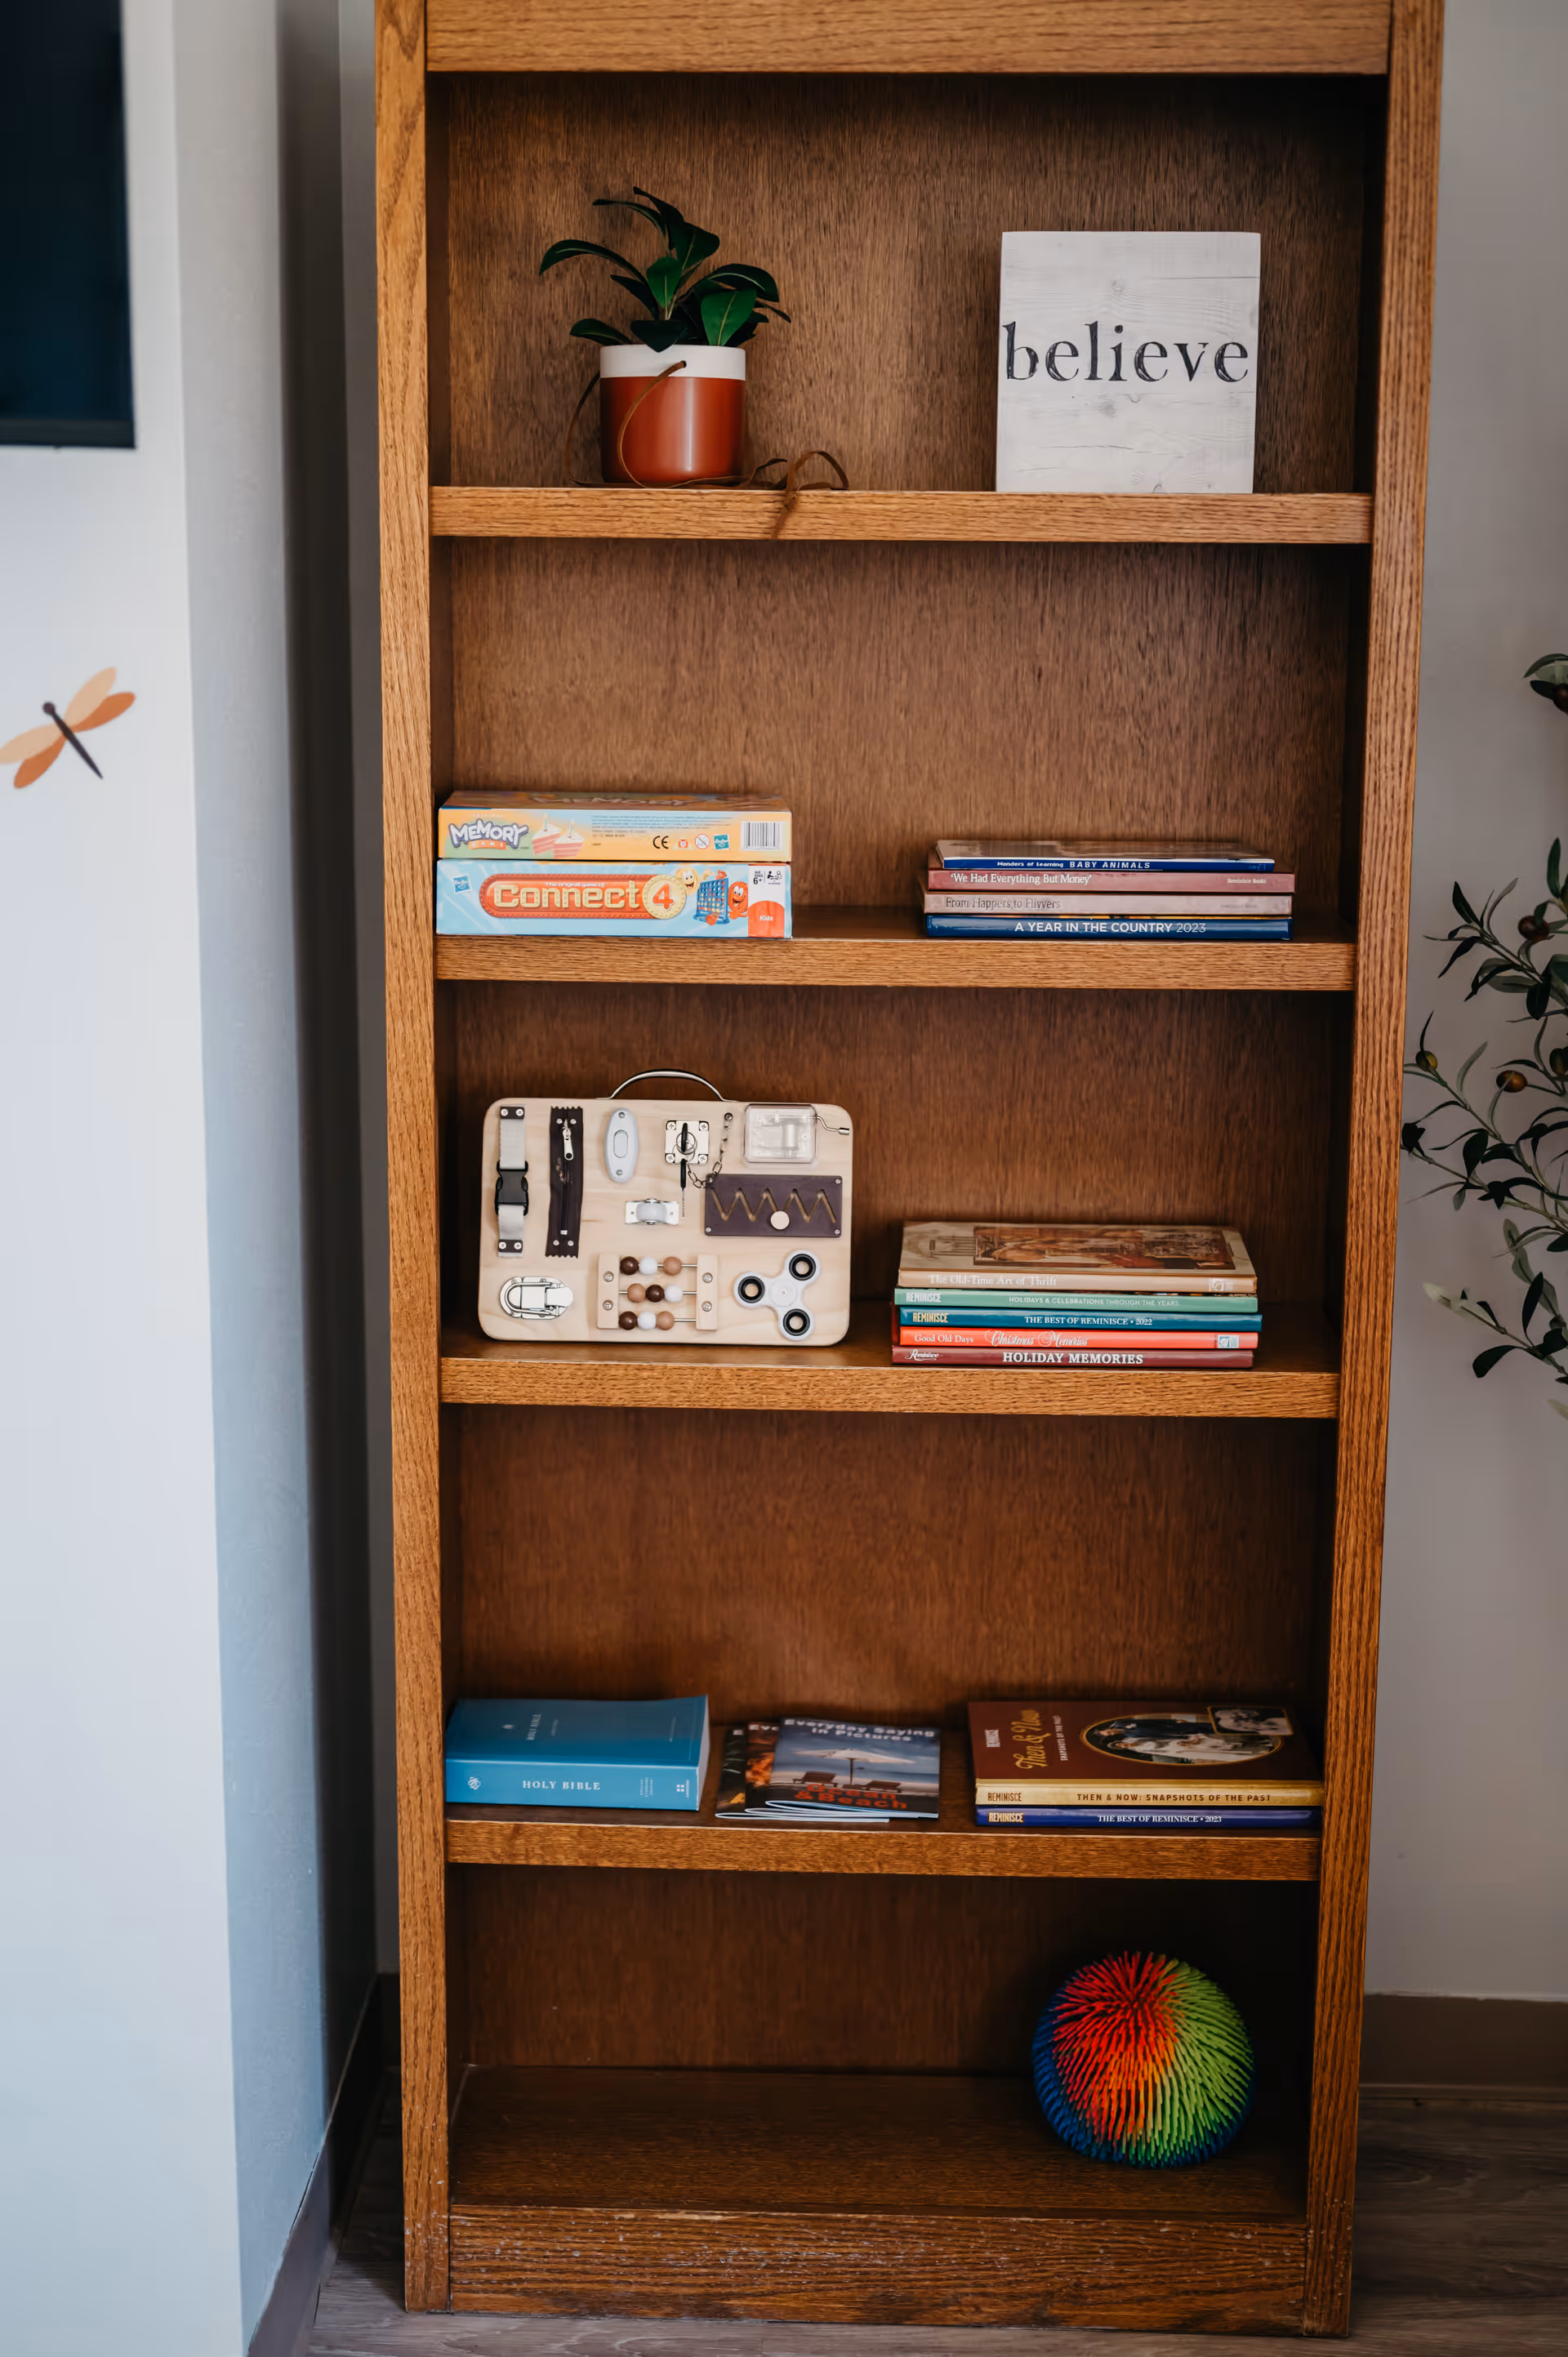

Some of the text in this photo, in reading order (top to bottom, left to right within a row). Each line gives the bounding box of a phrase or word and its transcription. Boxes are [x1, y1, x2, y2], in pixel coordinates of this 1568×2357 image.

[1002, 321, 1248, 382] believe
[449, 819, 528, 848] MEMORY
[753, 877, 763, 885] 6+
[970, 874, 988, 883] Had
[991, 874, 1040, 885] Everything
[1043, 874, 1058, 884] But
[494, 880, 675, 909] Connect 4
[946, 897, 1061, 910] From Flappers to Flivvers
[1014, 923, 1205, 933] A YEAR IN THE COUNTRY 2023
[929, 1274, 1057, 1285] The Old-Time Art of Thrift
[906, 1292, 941, 1303] REMINISCE
[1052, 1297, 1104, 1305] CELEBRATIONS
[913, 1312, 949, 1323] REMINISCE
[915, 1334, 973, 1343] Good Old Days
[985, 1330, 1088, 1348] Christmas Memories
[905, 1349, 939, 1361] Reminisce
[1003, 1352, 1143, 1364] HOLIDAY MEMORIES
[1010, 1709, 1052, 1769] Then & Now
[523, 1780, 601, 1790] HOLY BIBLE
[807, 1784, 897, 1800] Ocean
[988, 1793, 1022, 1802] REMINISCE
[1146, 1793, 1205, 1802] SNAPSHOTS
[988, 1813, 1024, 1823] REMINISCE
